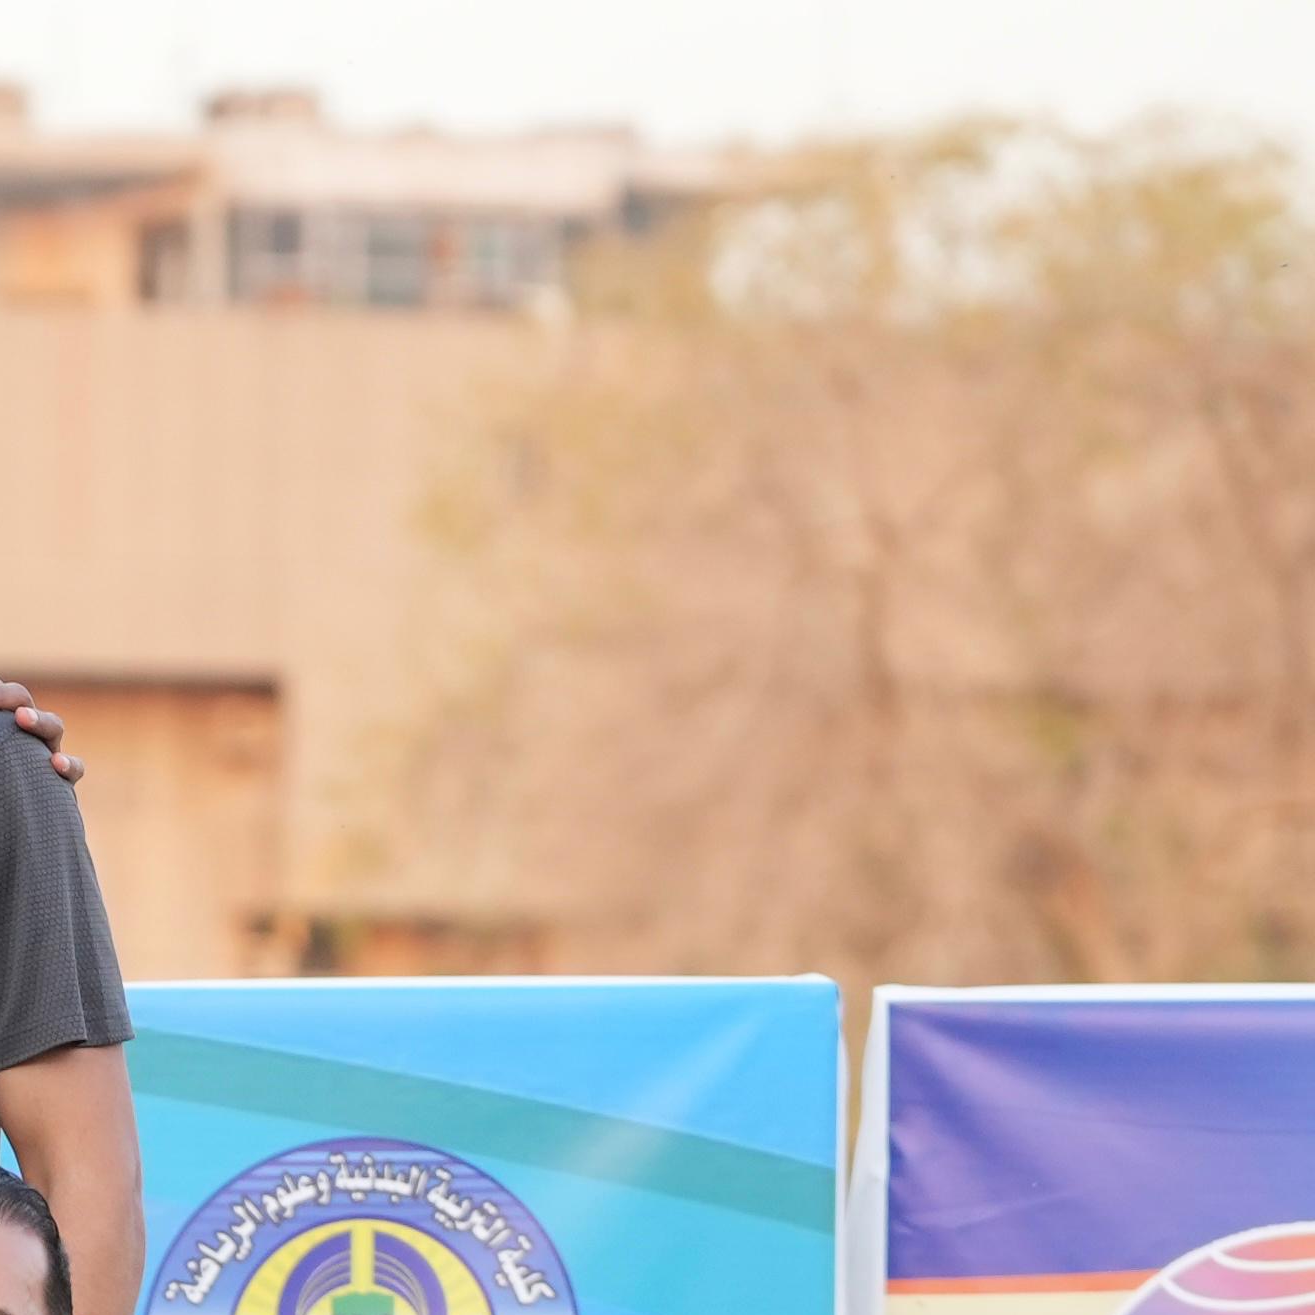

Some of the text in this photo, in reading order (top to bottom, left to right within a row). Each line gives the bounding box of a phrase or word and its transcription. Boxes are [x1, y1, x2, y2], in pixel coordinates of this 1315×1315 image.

[165, 1153, 556, 1305] كلية التربية البدنية وعلوم الرياضة
